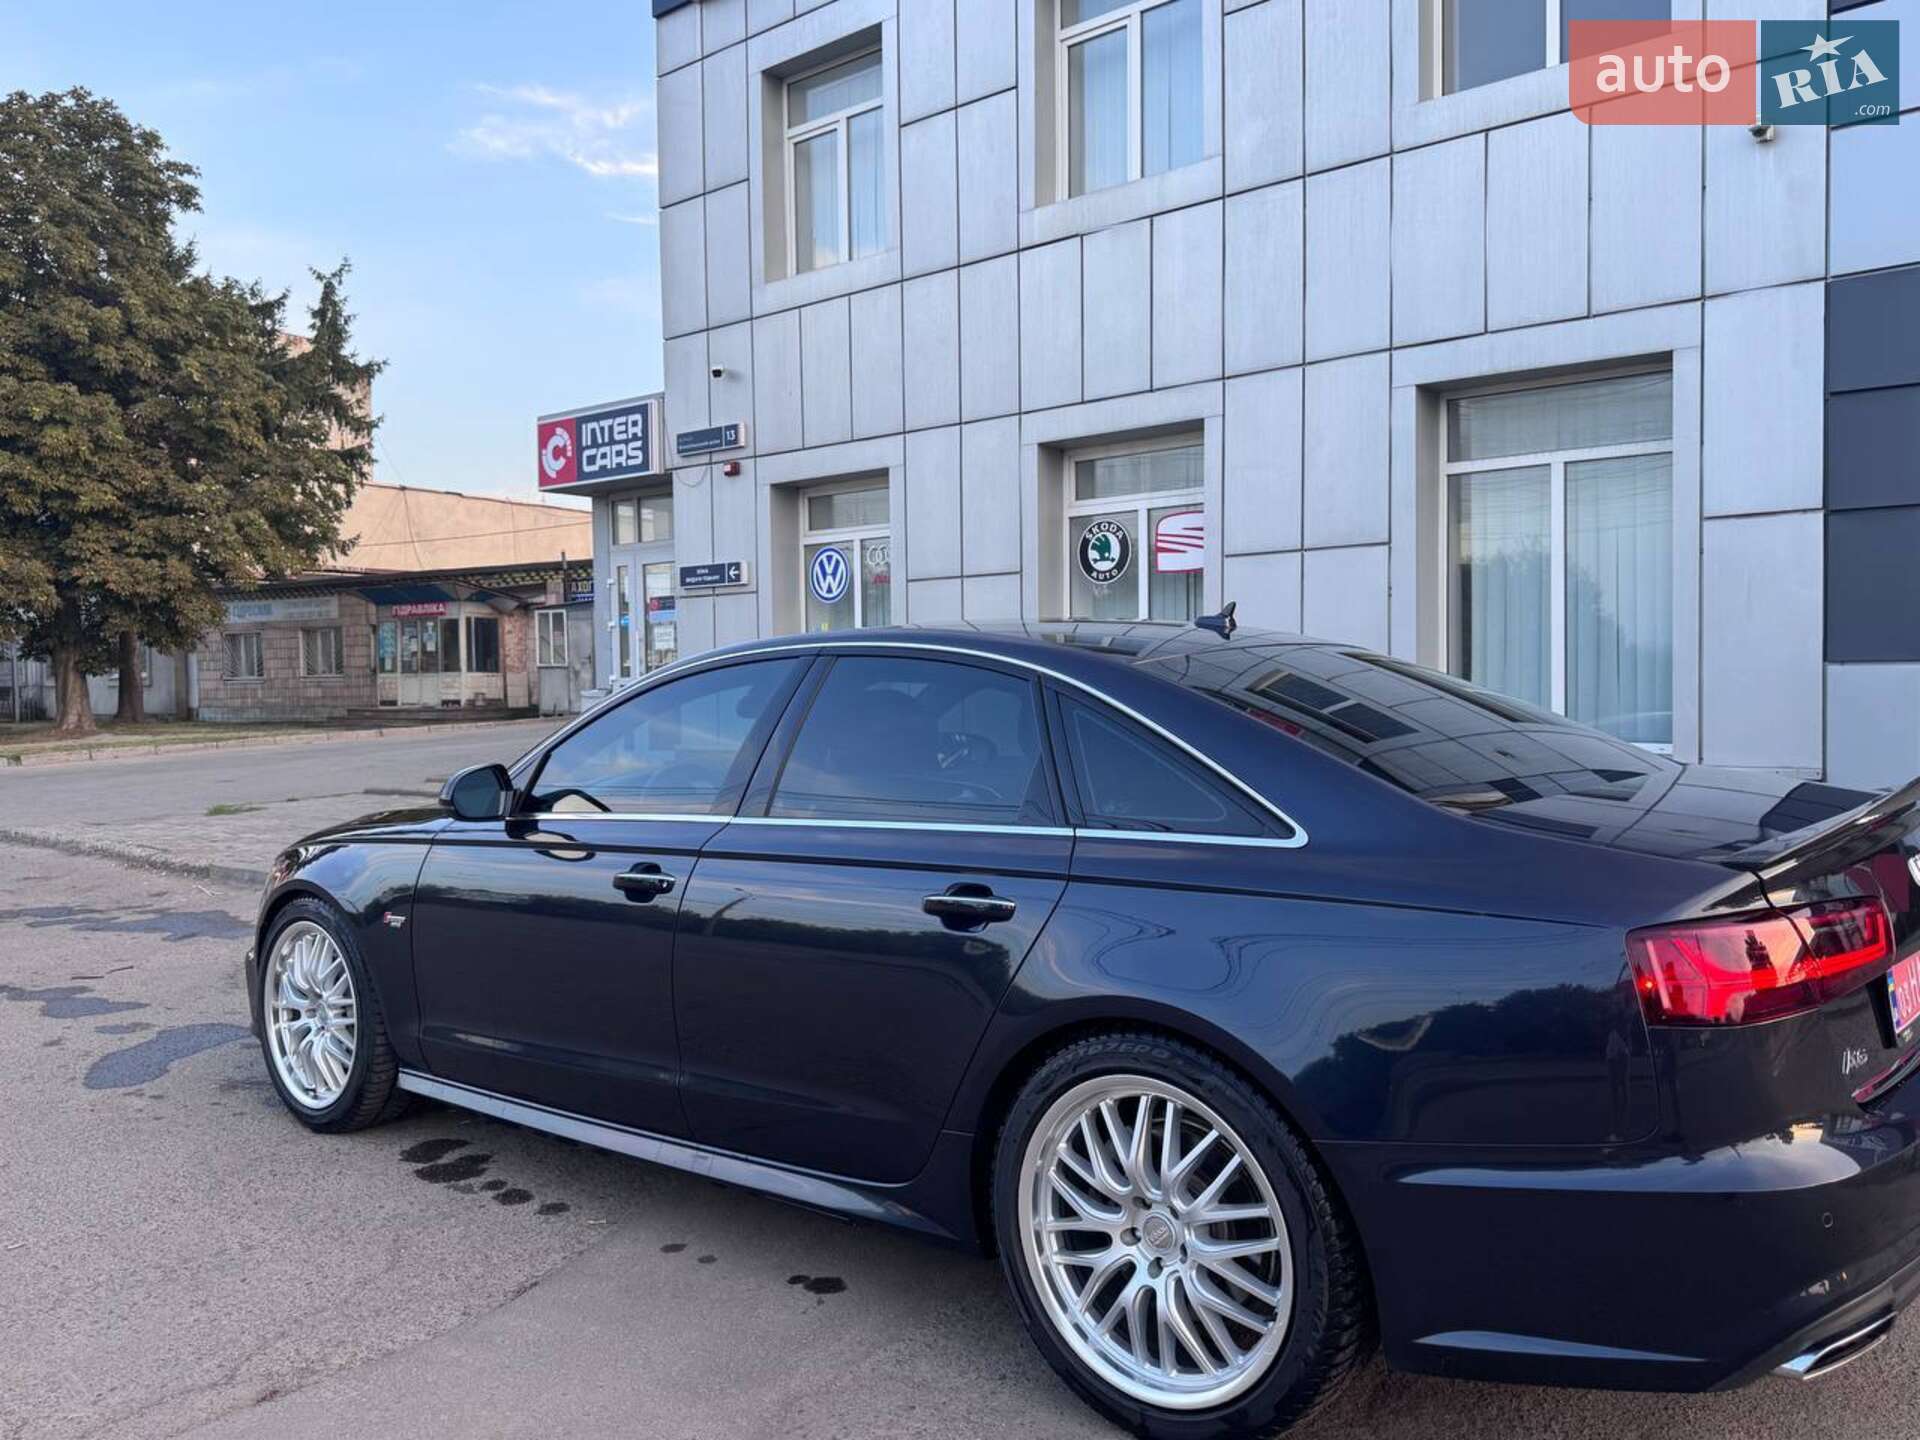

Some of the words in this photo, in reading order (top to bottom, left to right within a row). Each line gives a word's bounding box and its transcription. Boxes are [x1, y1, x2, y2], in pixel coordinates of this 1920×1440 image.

[581, 413, 643, 448] INTER
[581, 441, 643, 473] CARS
[1090, 568, 1119, 580] AUTO
